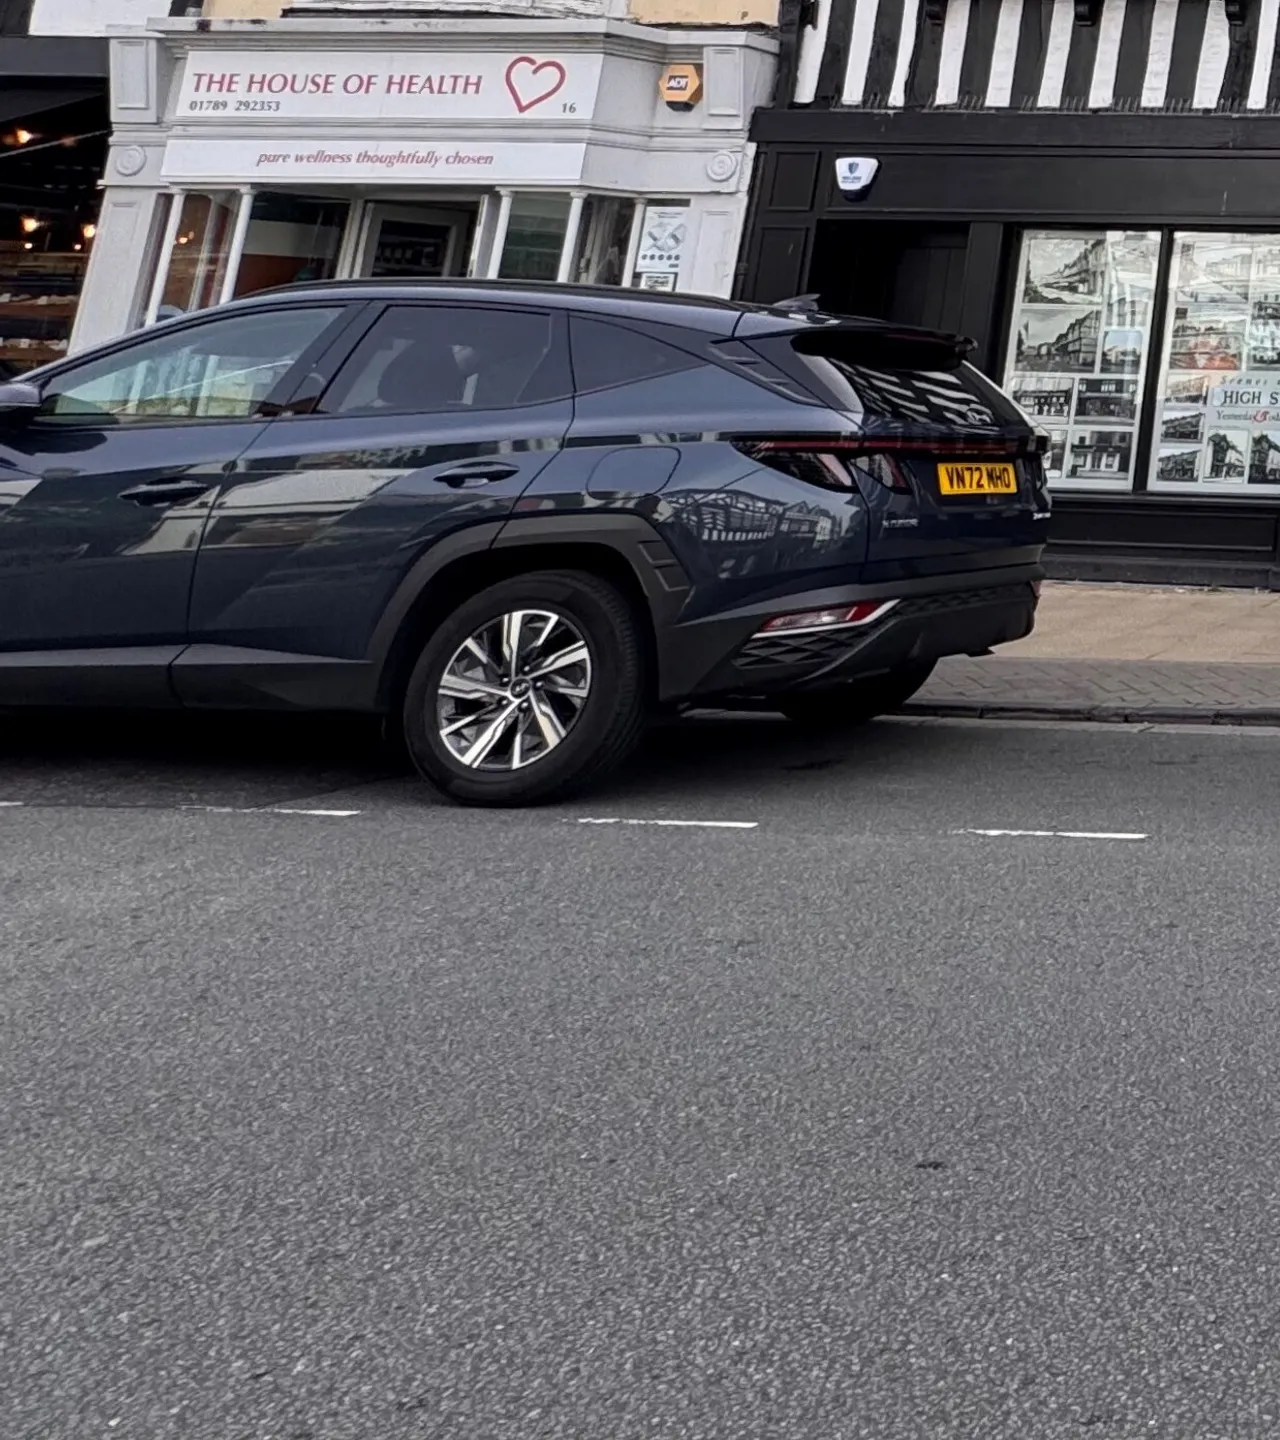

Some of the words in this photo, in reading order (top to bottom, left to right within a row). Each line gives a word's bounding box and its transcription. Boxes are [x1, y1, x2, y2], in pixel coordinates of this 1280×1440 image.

[193, 73, 241, 93] THE
[246, 73, 337, 94] HOUSE
[343, 73, 378, 94] OF
[385, 74, 482, 95] HEALTH
[667, 77, 689, 88] ADT
[189, 100, 228, 111] 01789
[234, 100, 281, 112] 292353
[561, 103, 577, 114] 16
[256, 153, 290, 167] pure
[294, 150, 352, 164] wellness
[356, 150, 441, 167] thoughtfully
[445, 153, 494, 165] chosen
[1223, 391, 1262, 405] HIGH
[946, 466, 984, 489] VN72
